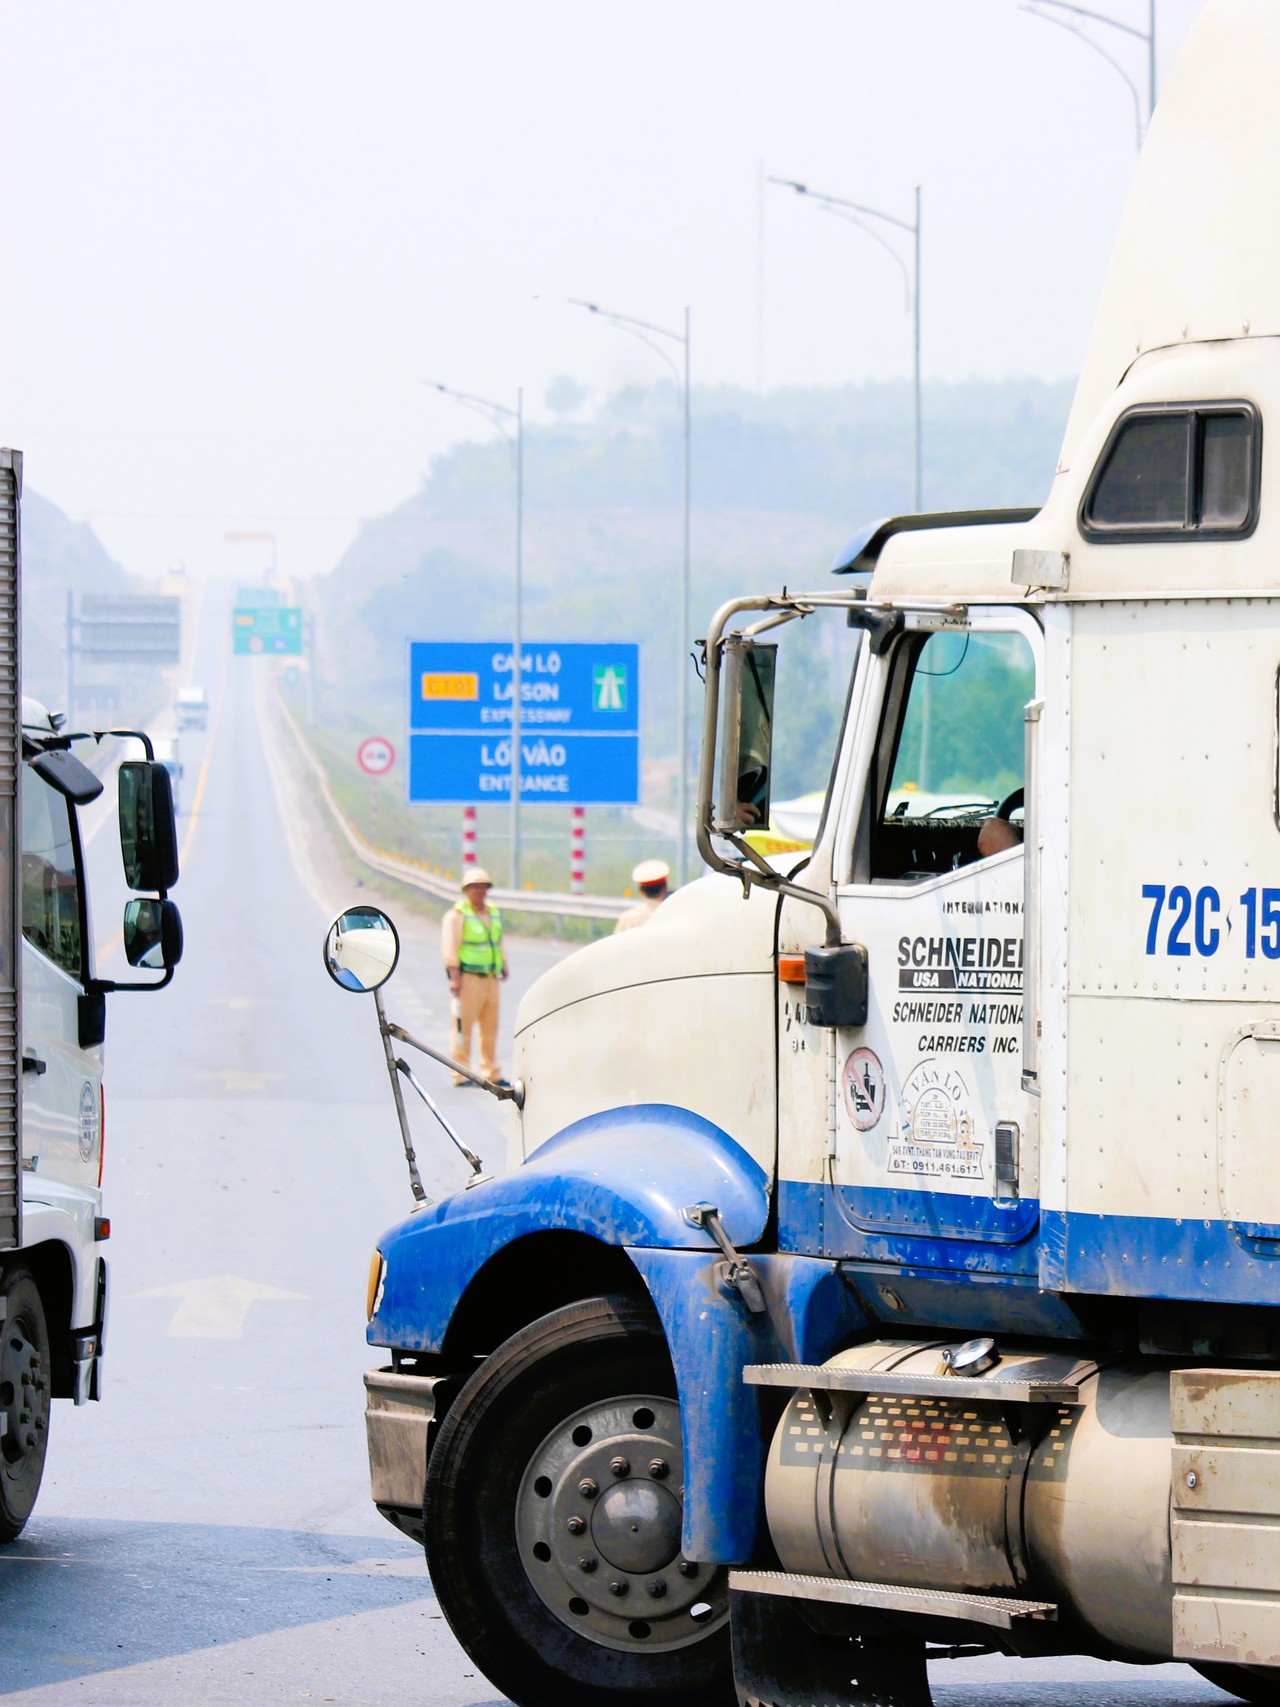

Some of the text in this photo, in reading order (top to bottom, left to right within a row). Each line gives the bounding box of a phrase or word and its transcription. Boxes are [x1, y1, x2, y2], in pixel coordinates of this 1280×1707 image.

[481, 738, 515, 767] LỐ
[1142, 884, 1220, 957] 72C
[912, 972, 939, 988] USA
[892, 1001, 963, 1023] SCHNEIDER
[918, 1035, 1019, 1053] CARRIERS INC.
